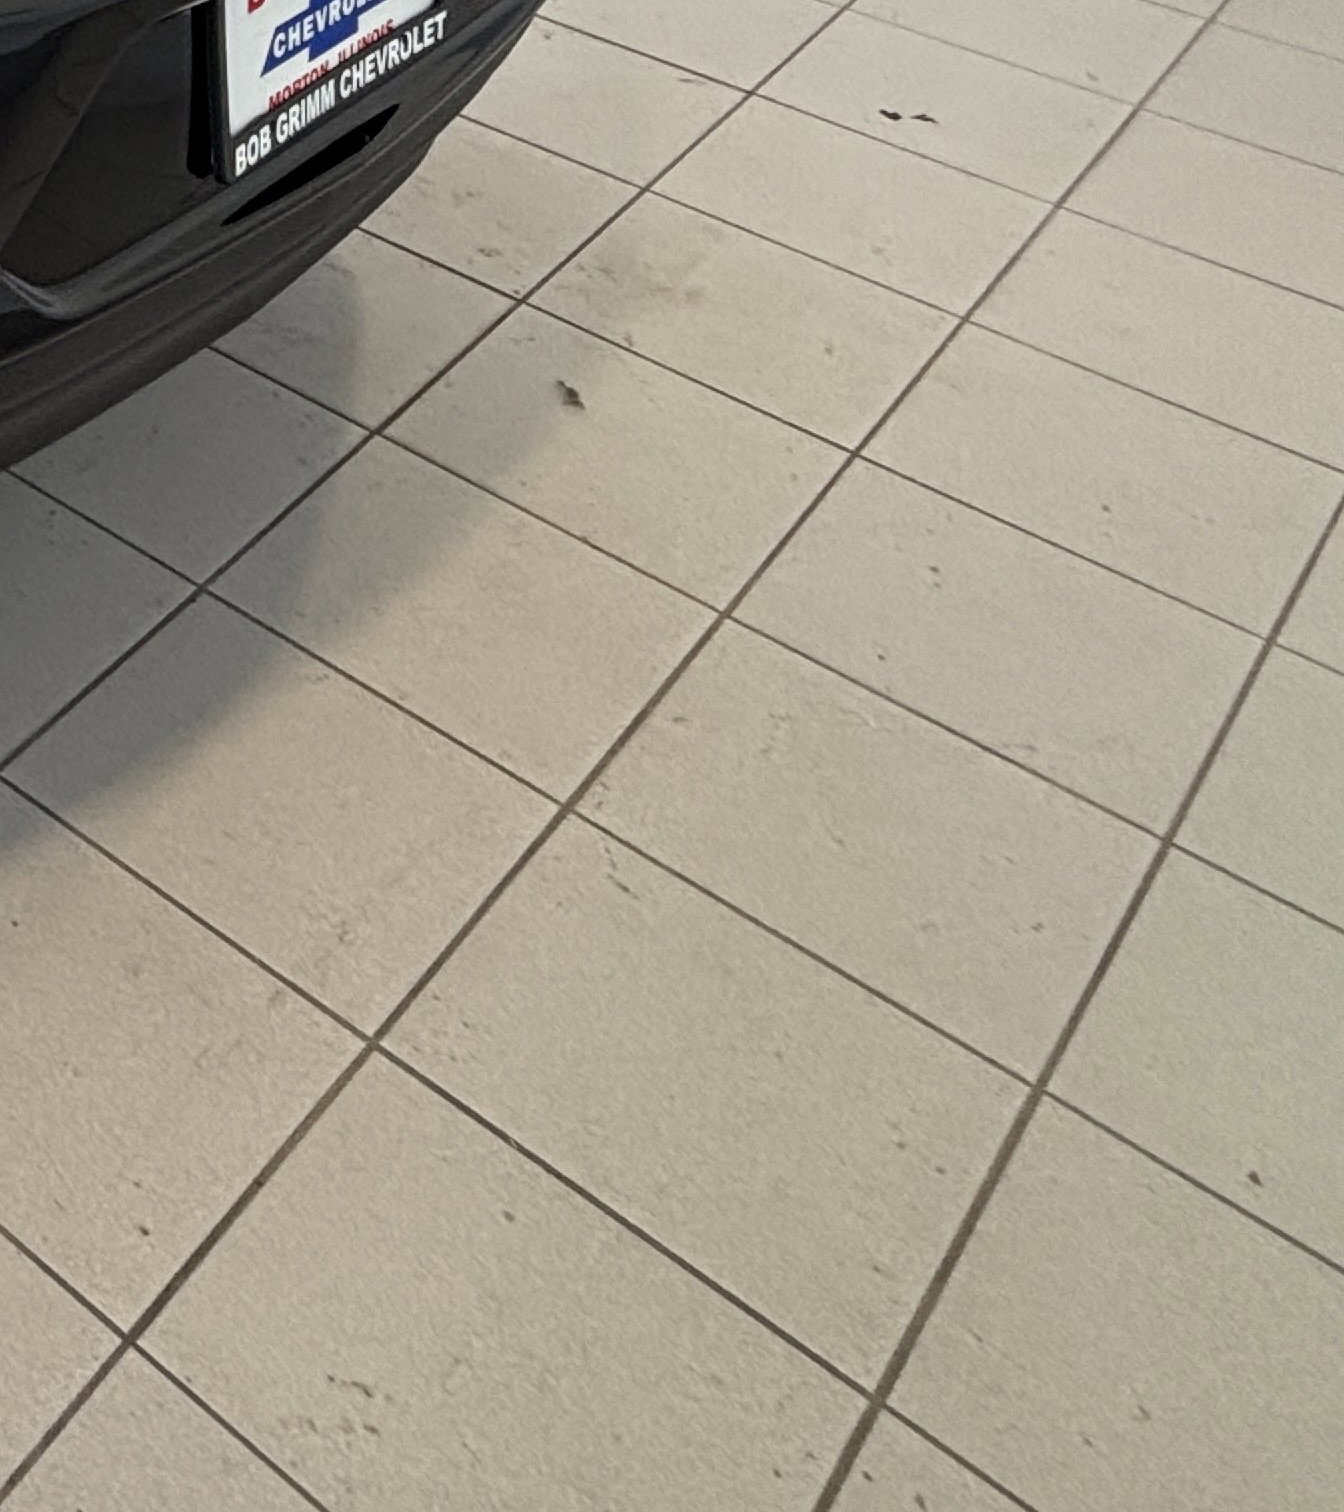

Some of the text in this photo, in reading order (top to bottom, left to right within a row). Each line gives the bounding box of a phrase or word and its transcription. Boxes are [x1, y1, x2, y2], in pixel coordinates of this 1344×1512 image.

[234, 9, 448, 178] BOB GRIMM CHEVROLET
